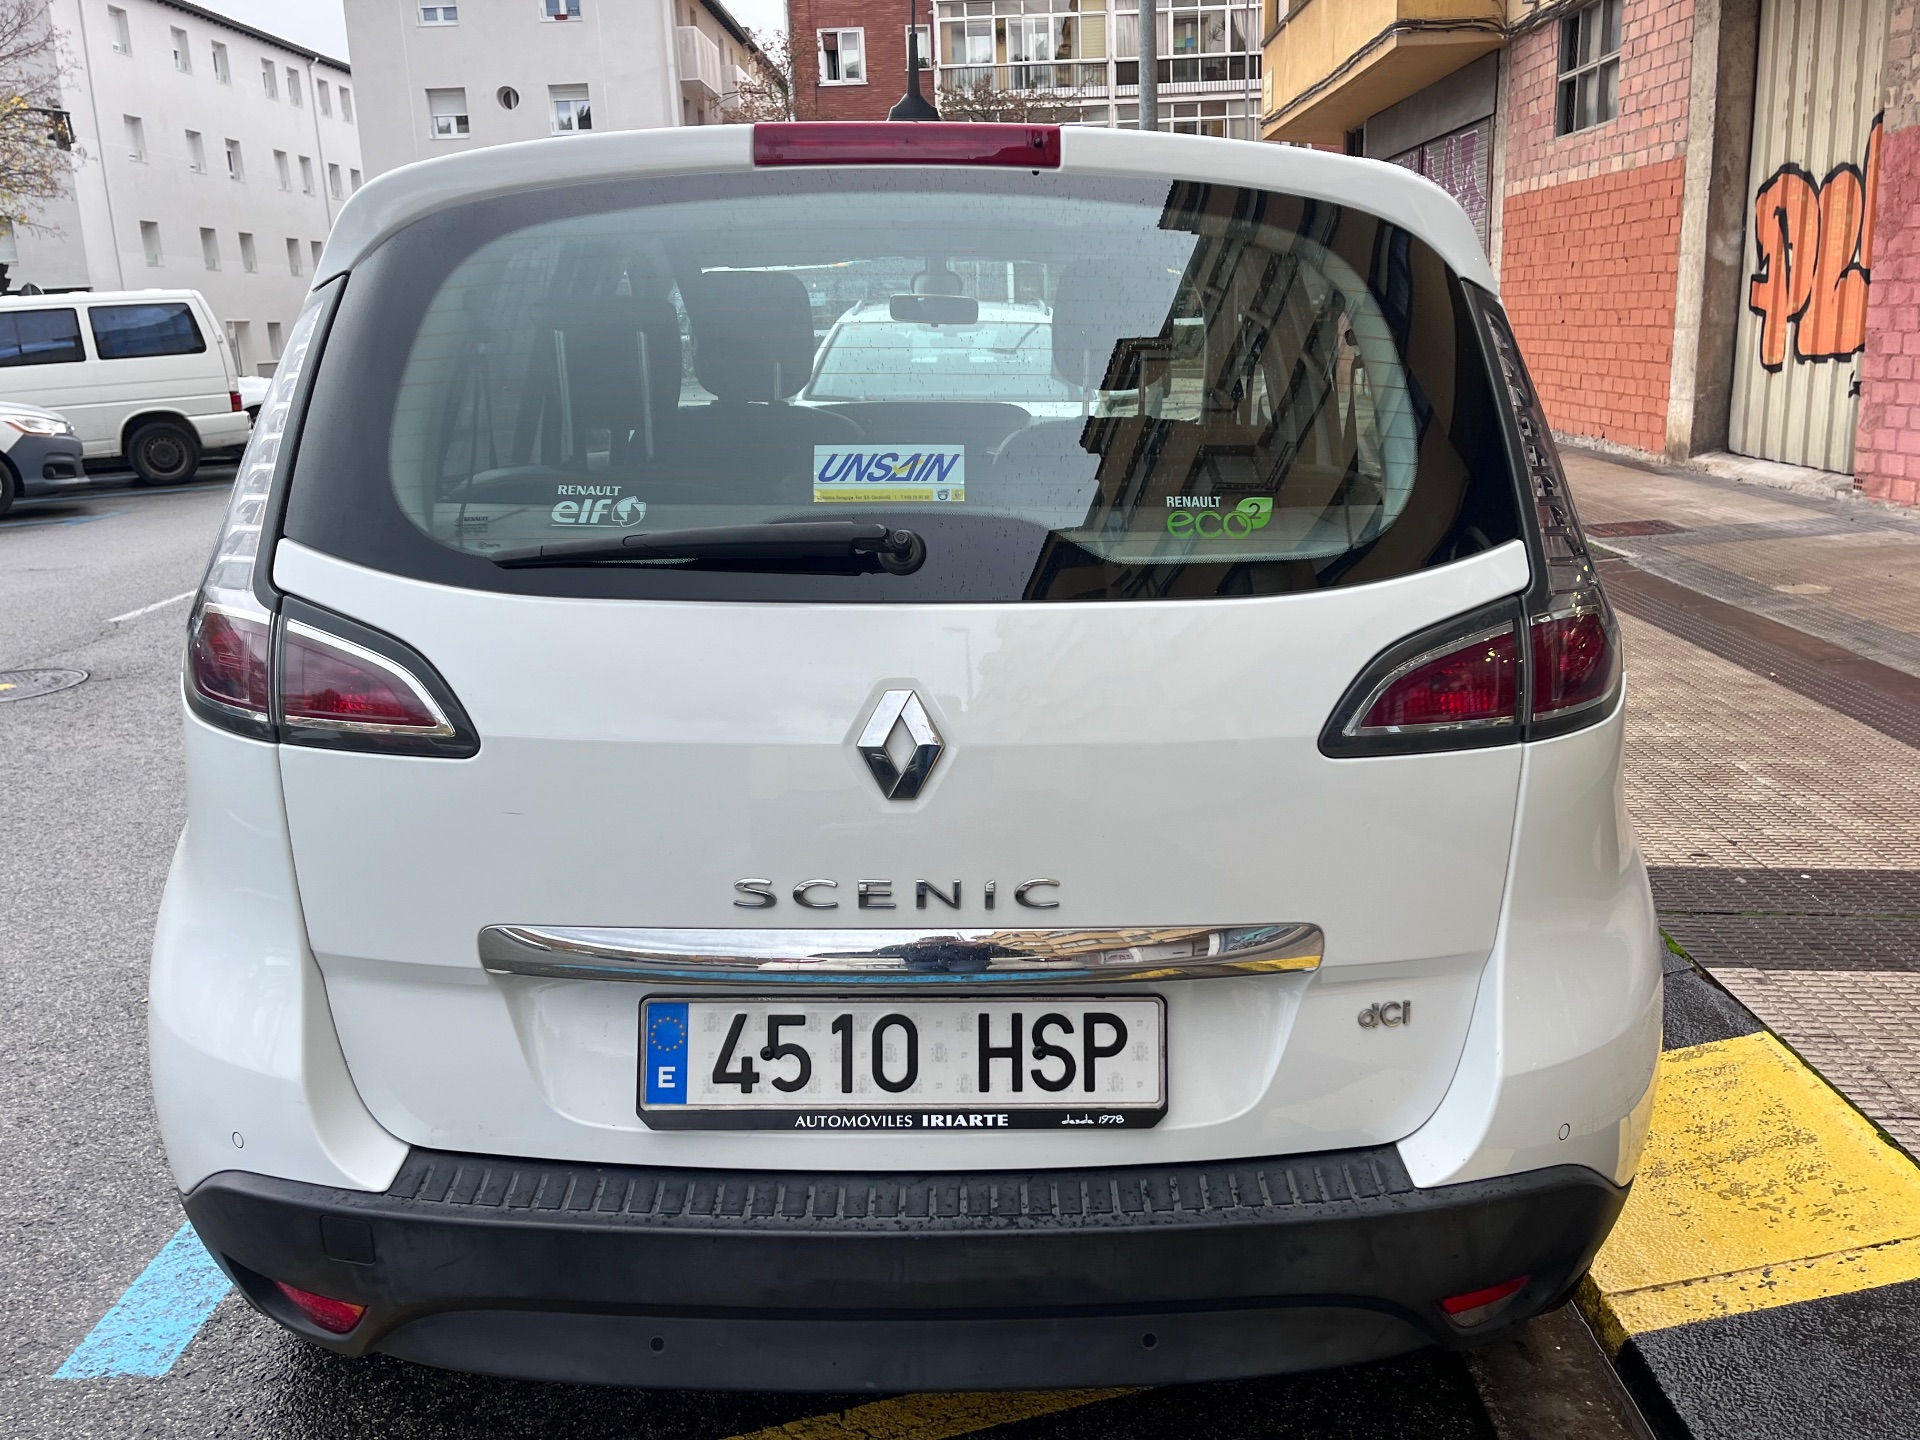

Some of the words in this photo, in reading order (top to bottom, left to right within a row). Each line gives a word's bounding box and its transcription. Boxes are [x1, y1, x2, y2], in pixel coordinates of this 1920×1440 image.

[818, 453, 960, 482] UNSAIN
[557, 484, 622, 496] RENAULT
[551, 499, 612, 524] elf
[1166, 496, 1222, 508] RENAULT
[712, 1013, 918, 1093] 4510
[978, 1012, 1128, 1092] HSP
[657, 1066, 676, 1088] E
[794, 1113, 913, 1127] AUTOMÓVILES
[922, 1114, 1009, 1127] IRIARTE
[1061, 1114, 1094, 1125] desde
[1098, 1114, 1125, 1124] 1978
